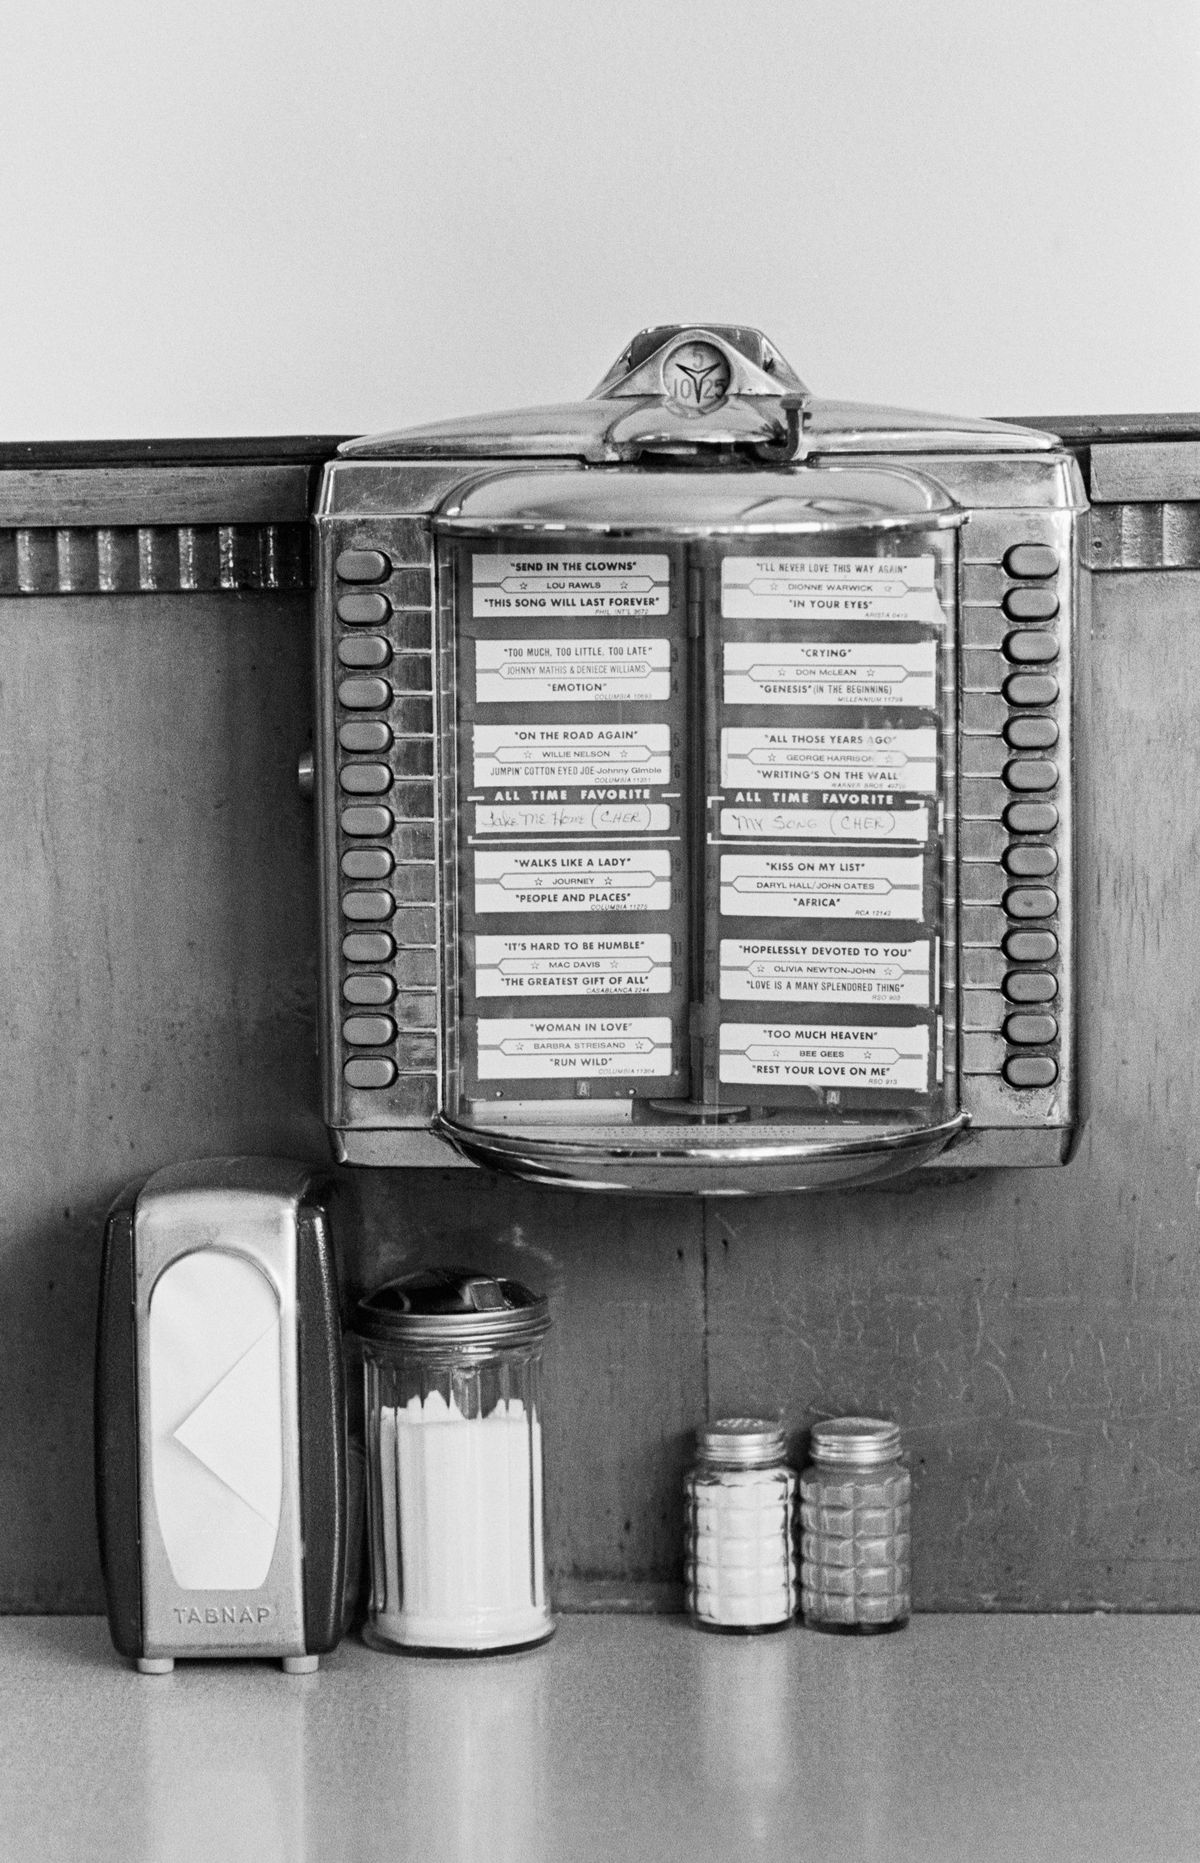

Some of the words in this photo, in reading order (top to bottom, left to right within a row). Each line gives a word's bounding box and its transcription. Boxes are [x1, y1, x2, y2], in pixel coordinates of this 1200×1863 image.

[692, 347, 703, 368] 5
[673, 378, 691, 399] 10
[703, 379, 726, 399] 25
[511, 563, 543, 571] "SEND
[547, 563, 559, 571] IN
[563, 562, 581, 571] THE
[585, 562, 636, 571] CLOWNS"
[780, 563, 805, 572] NEVER
[809, 564, 829, 573] LOVE
[834, 564, 851, 573] THIS
[879, 565, 907, 573] AGAIN"
[484, 599, 512, 607] "THIS
[515, 599, 546, 607] SONG
[580, 598, 604, 606] LAST
[609, 597, 659, 606] FOREVER"
[810, 600, 839, 608] YOUR
[845, 601, 872, 609] EYES"
[504, 648, 523, 657] "TOO
[557, 648, 571, 656] TOO
[610, 647, 624, 655] TOO
[627, 647, 652, 655] LATE"
[801, 649, 851, 657] "CRYING"
[507, 665, 535, 675] JOHNNY
[539, 665, 567, 675] MATHIS
[570, 665, 575, 675] &
[577, 665, 607, 675] DENIECE
[610, 665, 645, 675] WILLIAMS
[760, 685, 812, 693] "GENESIS"
[813, 685, 824, 693] (IN
[829, 685, 842, 693] THE
[847, 685, 892, 694] BEGINNING)
[515, 732, 535, 740] "ON
[564, 731, 593, 739] ROAD
[597, 731, 638, 739] AGAIN"
[765, 735, 787, 743] "ALL
[792, 735, 825, 743] THOSE
[830, 736, 863, 744] YEARS
[490, 766, 522, 776] JUMPIN'
[524, 766, 555, 776] COTTON
[558, 766, 578, 776] EYED
[580, 766, 594, 776] JOE
[597, 767, 628, 775] Johnny
[757, 770, 819, 779] "WRITING'S
[824, 771, 841, 779] ON
[495, 791, 519, 801] ALL
[532, 791, 567, 800] TIME
[581, 789, 650, 799] FAVORITE
[735, 792, 761, 802] ALL
[773, 792, 809, 803] TIME
[823, 794, 893, 805] FAVORITE
[515, 859, 557, 867] "WALKS
[598, 858, 631, 866] LADY"
[766, 862, 794, 871] "KISS
[798, 863, 815, 871] ON
[840, 863, 865, 871] LIST"
[516, 894, 558, 902] "PEOPLE
[562, 894, 585, 902] AND
[589, 893, 630, 901] PLACES"
[793, 898, 840, 906] "AFRICA"
[505, 943, 526, 951] "IT'S
[565, 942, 578, 950] TO
[583, 942, 594, 950] BE
[598, 941, 644, 950] HUMBLE"
[739, 946, 807, 954] "HOPELESSLY
[812, 947, 860, 956] DEVOTED
[865, 948, 879, 956] TO
[884, 949, 911, 957] YOU"
[501, 978, 524, 986] "THE
[528, 977, 578, 985] GREATEST
[582, 977, 604, 985] GIFT
[627, 976, 648, 984] ALL"
[747, 981, 771, 989] "LOVE
[774, 981, 782, 990] IS
[786, 981, 791, 989] A
[795, 982, 818, 990] MANY
[821, 982, 873, 991] SPLENDORED
[877, 983, 904, 992] THING"
[601, 1023, 633, 1031] LOVE"
[763, 1030, 791, 1038] "TOO
[795, 1031, 826, 1039] MUCH
[831, 1032, 878, 1040] HEAVEN"
[581, 1058, 612, 1066] WILD"
[753, 1065, 779, 1073] "REST
[785, 1066, 814, 1074] YOUR
[819, 1067, 845, 1075] LOVE
[850, 1067, 867, 1075] ON
[871, 1068, 890, 1076] ME"
[173, 1607, 271, 1624] TABNAP
